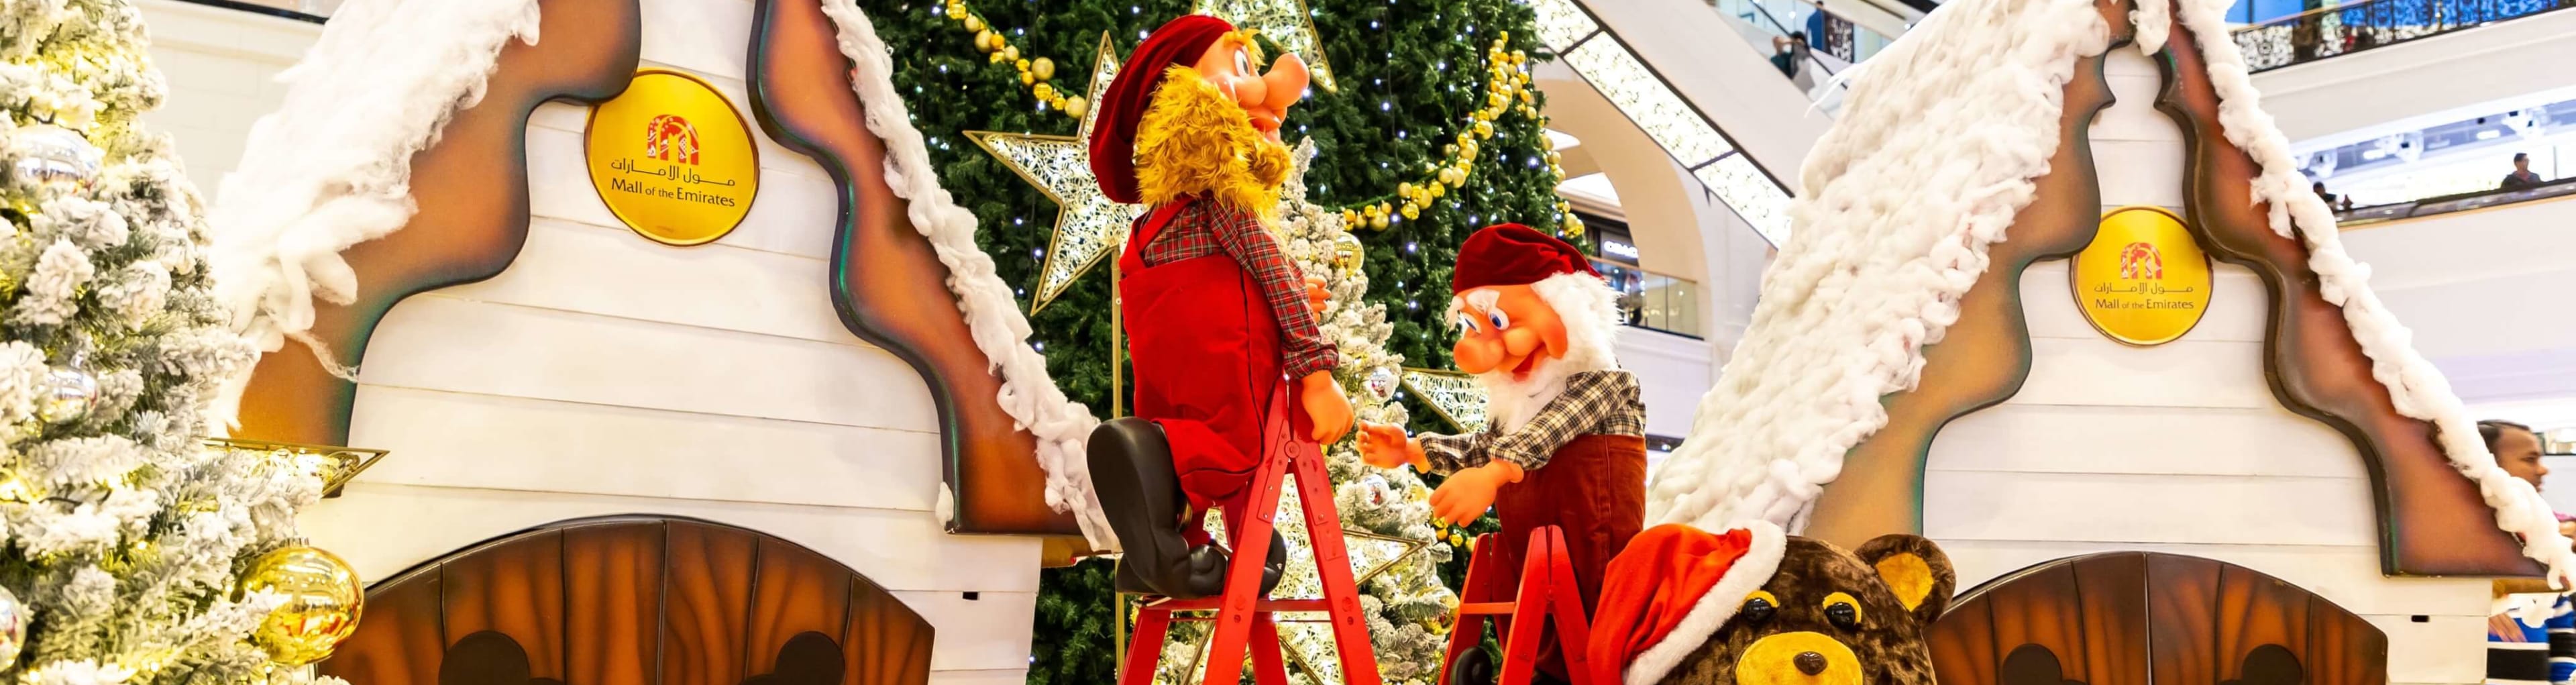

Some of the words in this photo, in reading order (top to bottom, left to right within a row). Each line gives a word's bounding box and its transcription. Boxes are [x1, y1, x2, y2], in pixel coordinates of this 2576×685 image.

[683, 168, 735, 187] مول
[611, 177, 643, 194] Mall
[645, 187, 656, 196] of
[658, 189, 674, 199] the
[676, 187, 735, 207] Emirates
[2151, 282, 2194, 295] مول
[2095, 299, 2120, 309] Mall
[2146, 299, 2194, 309] Emirates
